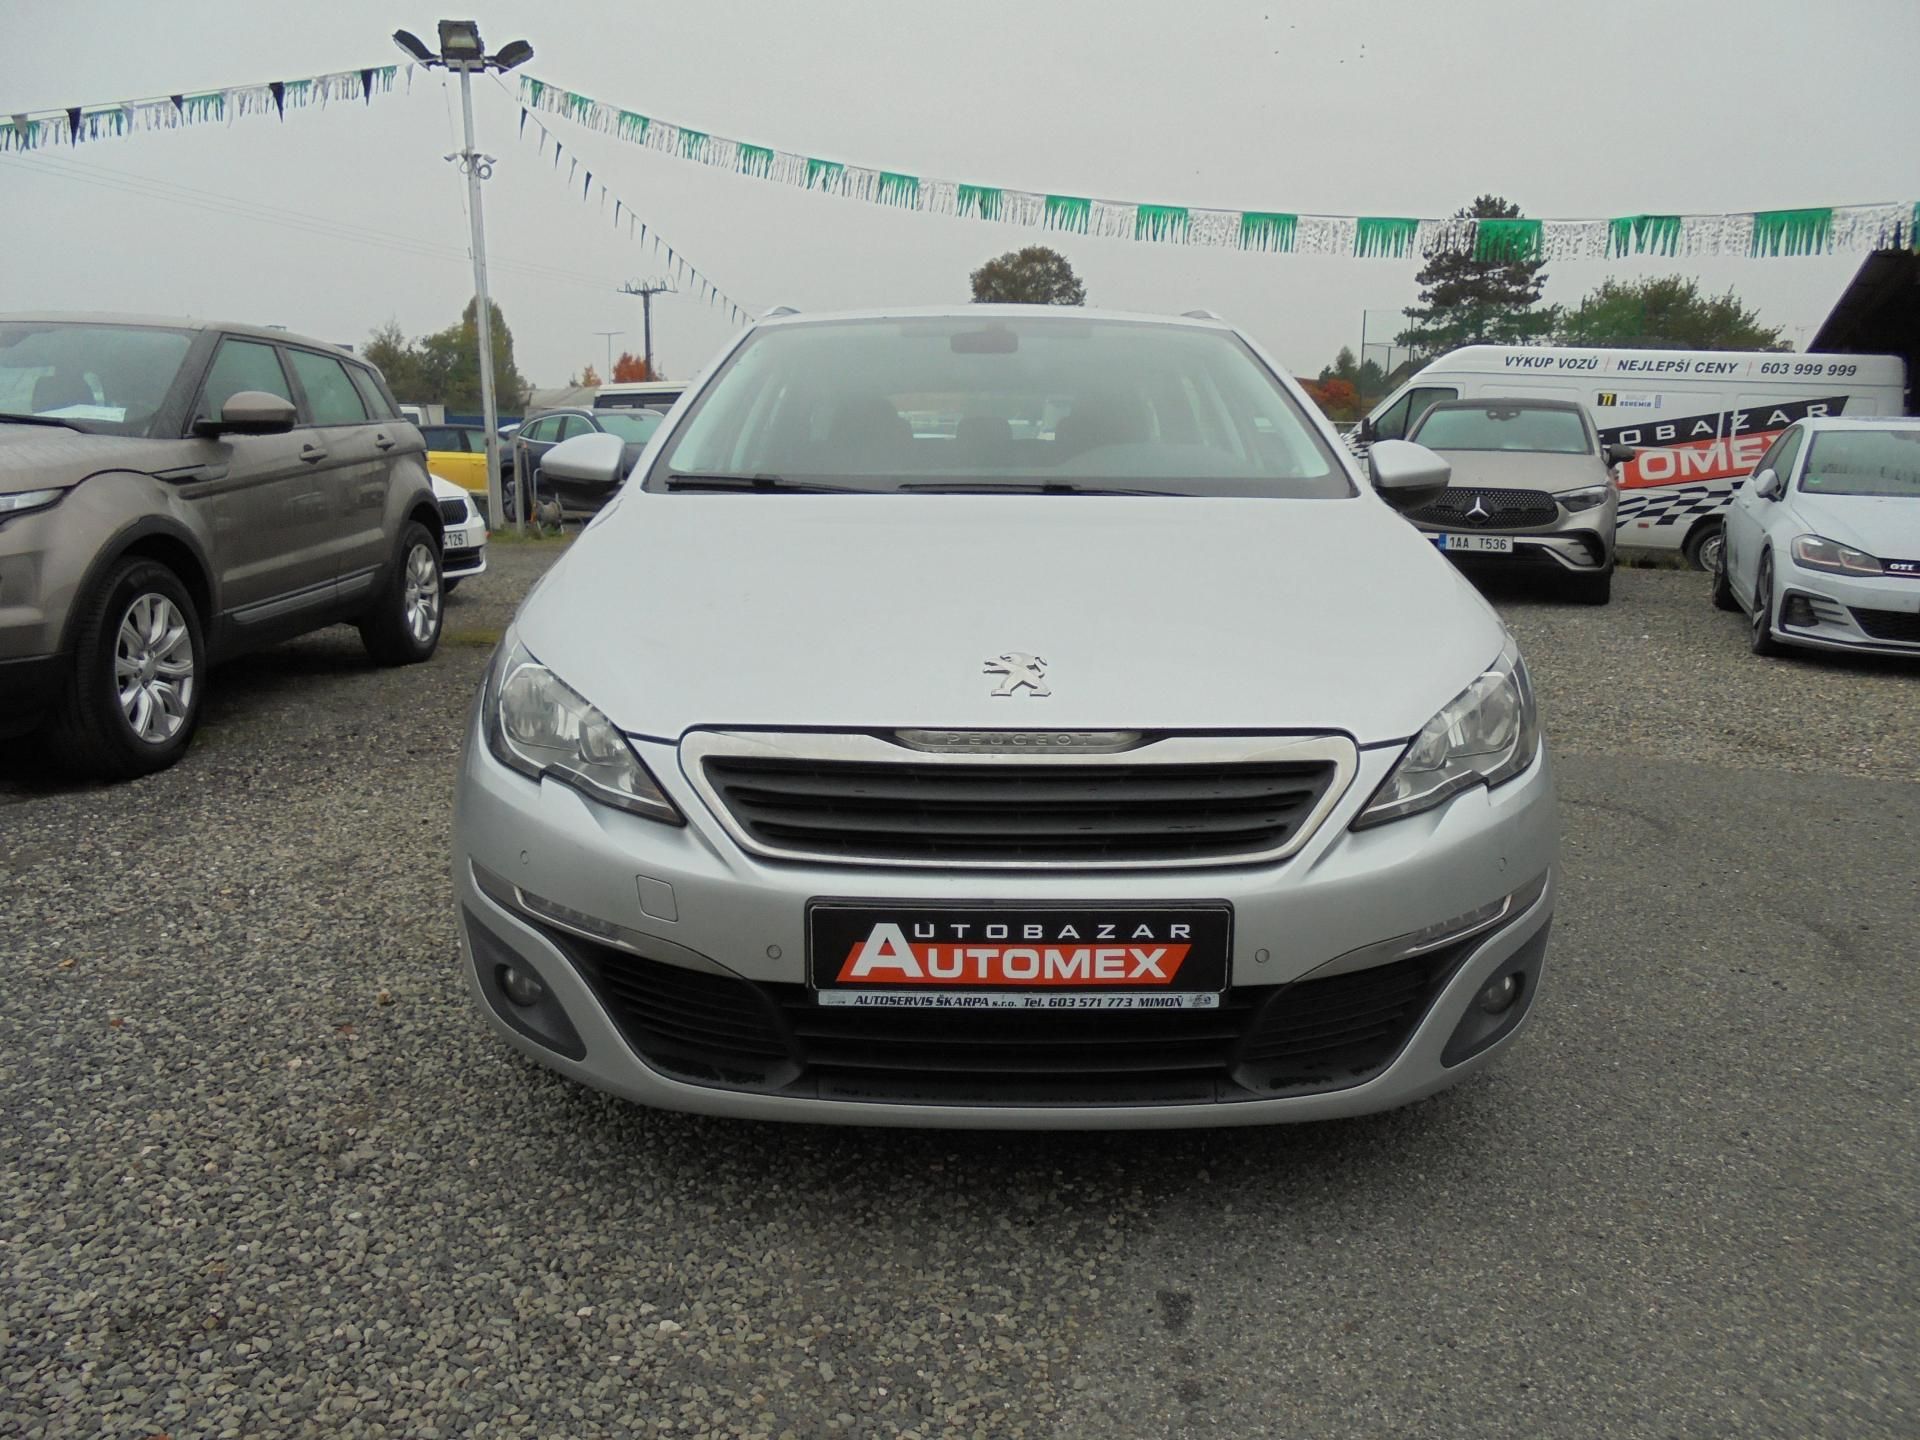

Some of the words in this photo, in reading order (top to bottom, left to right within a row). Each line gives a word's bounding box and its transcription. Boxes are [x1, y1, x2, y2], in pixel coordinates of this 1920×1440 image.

[1505, 354, 1554, 368] VÝKUP
[1617, 358, 1692, 372] NEJLEPŠÍ
[1694, 362, 1738, 374] CENY
[1761, 362, 1790, 375] 603
[1794, 363, 1823, 376] 999
[1827, 364, 1857, 377] 999
[1598, 403, 1828, 449] OBAZAR
[1449, 536, 1470, 549] 1AA
[1479, 537, 1507, 550] T536
[947, 733, 1092, 745] PEUGEOT
[850, 922, 1168, 979] AUTOMEX
[854, 995, 934, 1007] AUTOSERVIS
[935, 994, 990, 1008] ŠKARPA
[991, 1000, 1017, 1008] s.r.o.
[1024, 996, 1045, 1008] Tel.
[1049, 997, 1076, 1008] 603
[1078, 997, 1102, 1008] 571
[1107, 997, 1133, 1008] 773
